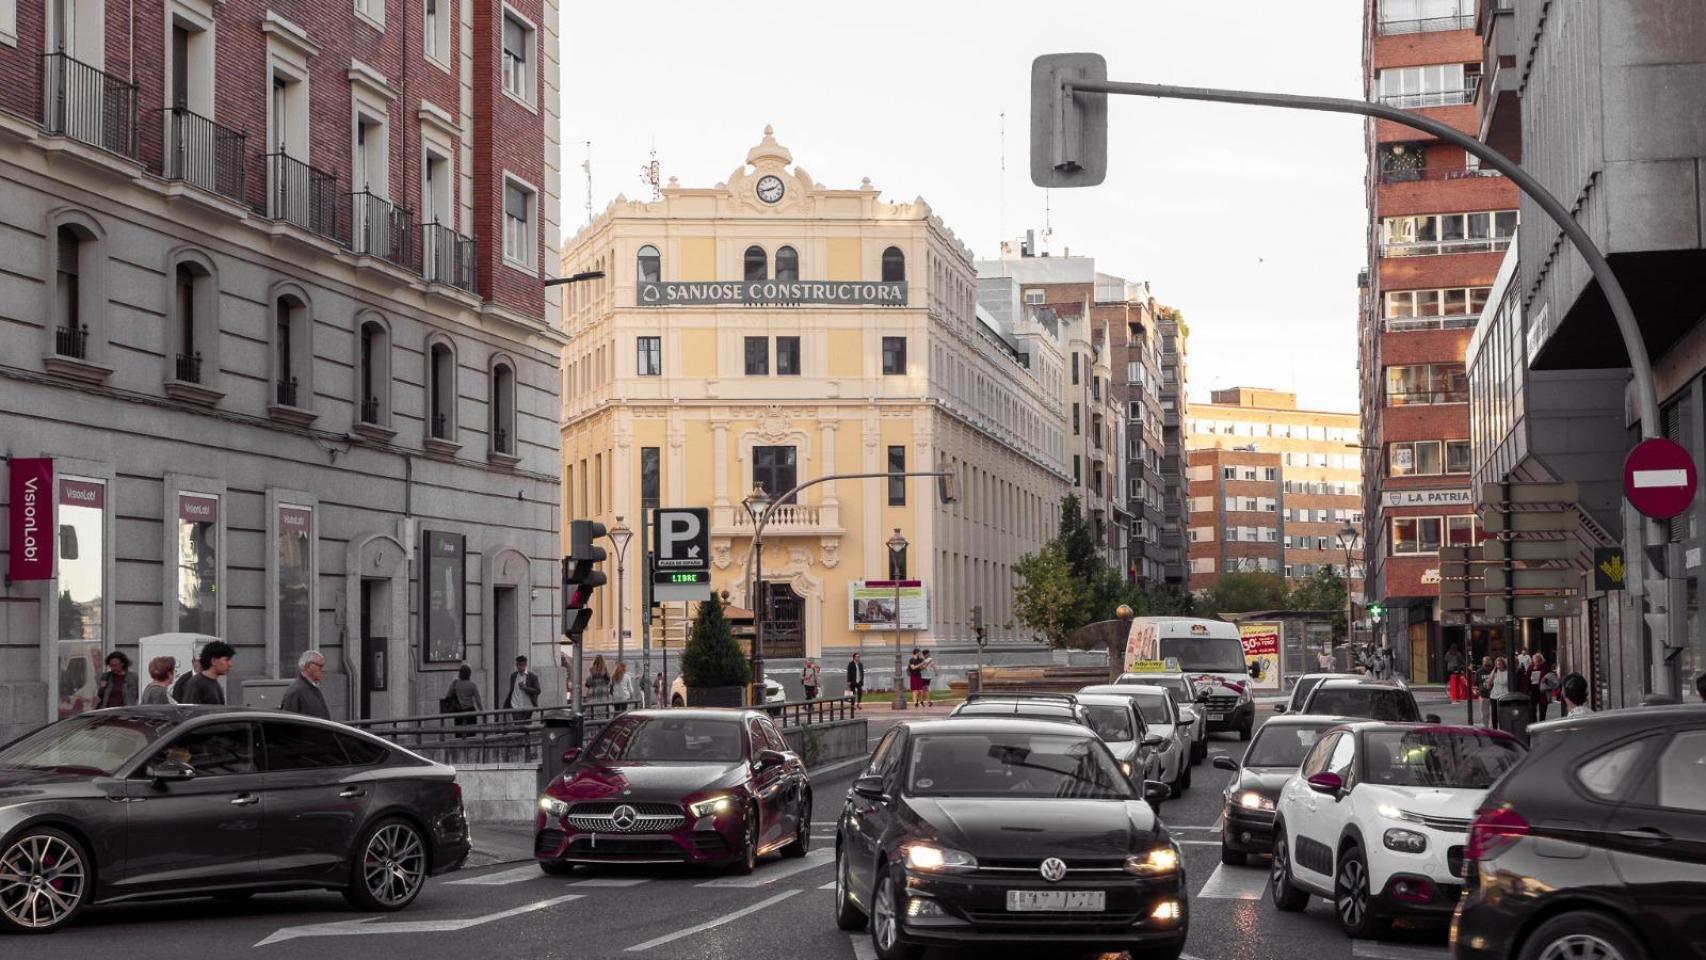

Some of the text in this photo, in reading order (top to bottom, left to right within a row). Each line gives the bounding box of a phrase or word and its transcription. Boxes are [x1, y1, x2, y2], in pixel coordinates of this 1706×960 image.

[666, 283, 902, 300] SANJOSE CONSTRUCTORA
[1408, 492, 1470, 502] LA PATRIA
[24, 476, 38, 562] VisionLab!
[660, 512, 701, 558] P
[672, 574, 697, 582] LIBRE
